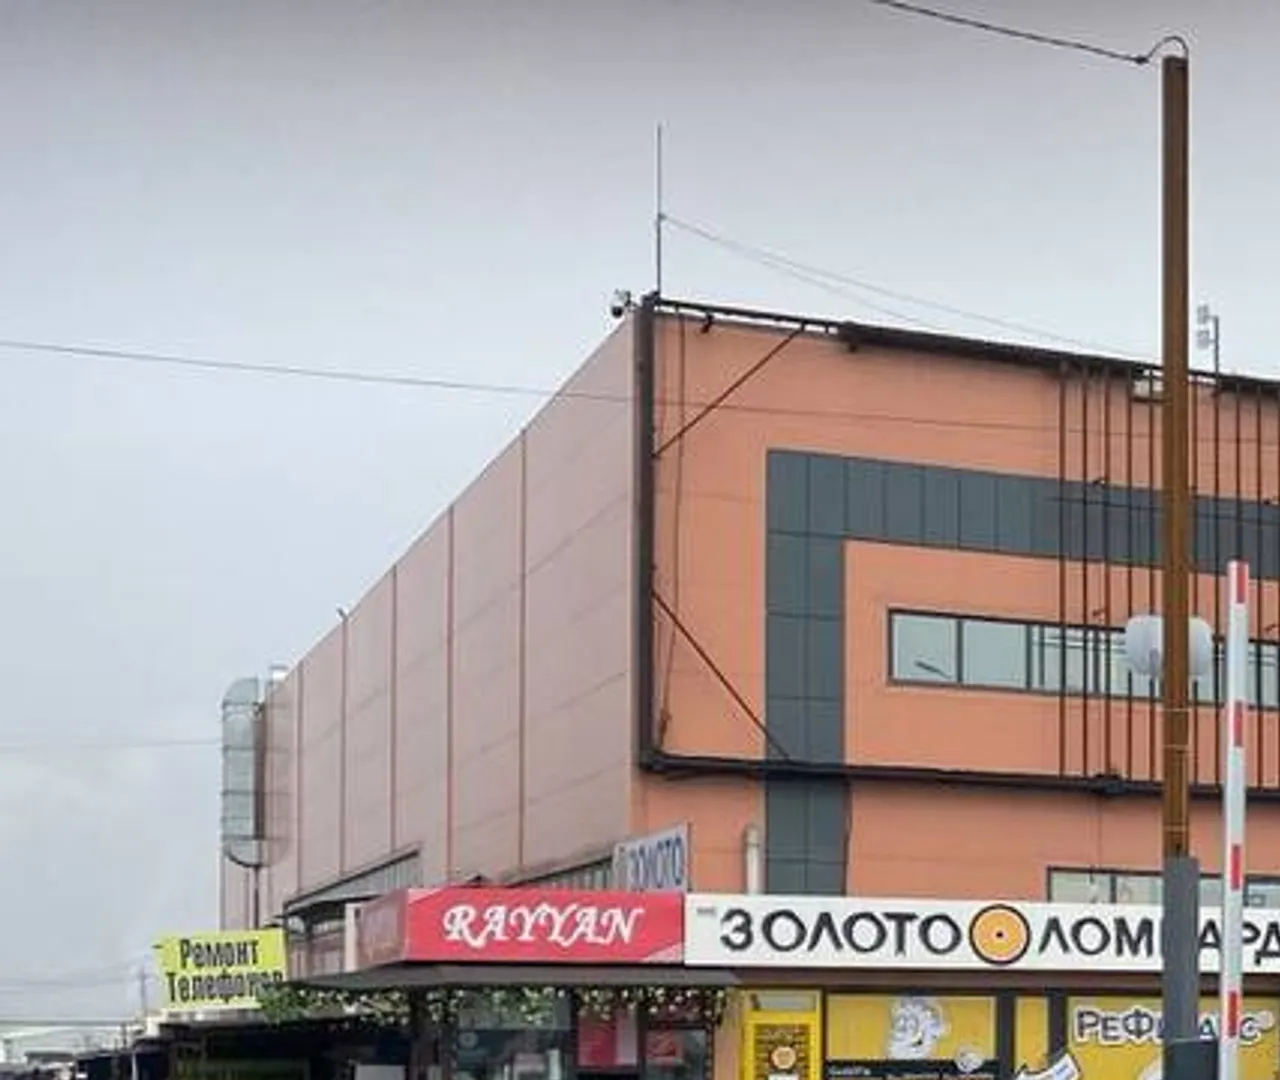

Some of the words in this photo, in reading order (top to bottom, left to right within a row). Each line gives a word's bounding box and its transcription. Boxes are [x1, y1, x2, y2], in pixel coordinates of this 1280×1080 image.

[443, 902, 644, 949] RAYYAN
[719, 908, 961, 955] ЗОЛОТО
[181, 939, 259, 968] Ремонт
[1076, 1008, 1262, 1042] РЕФАС
